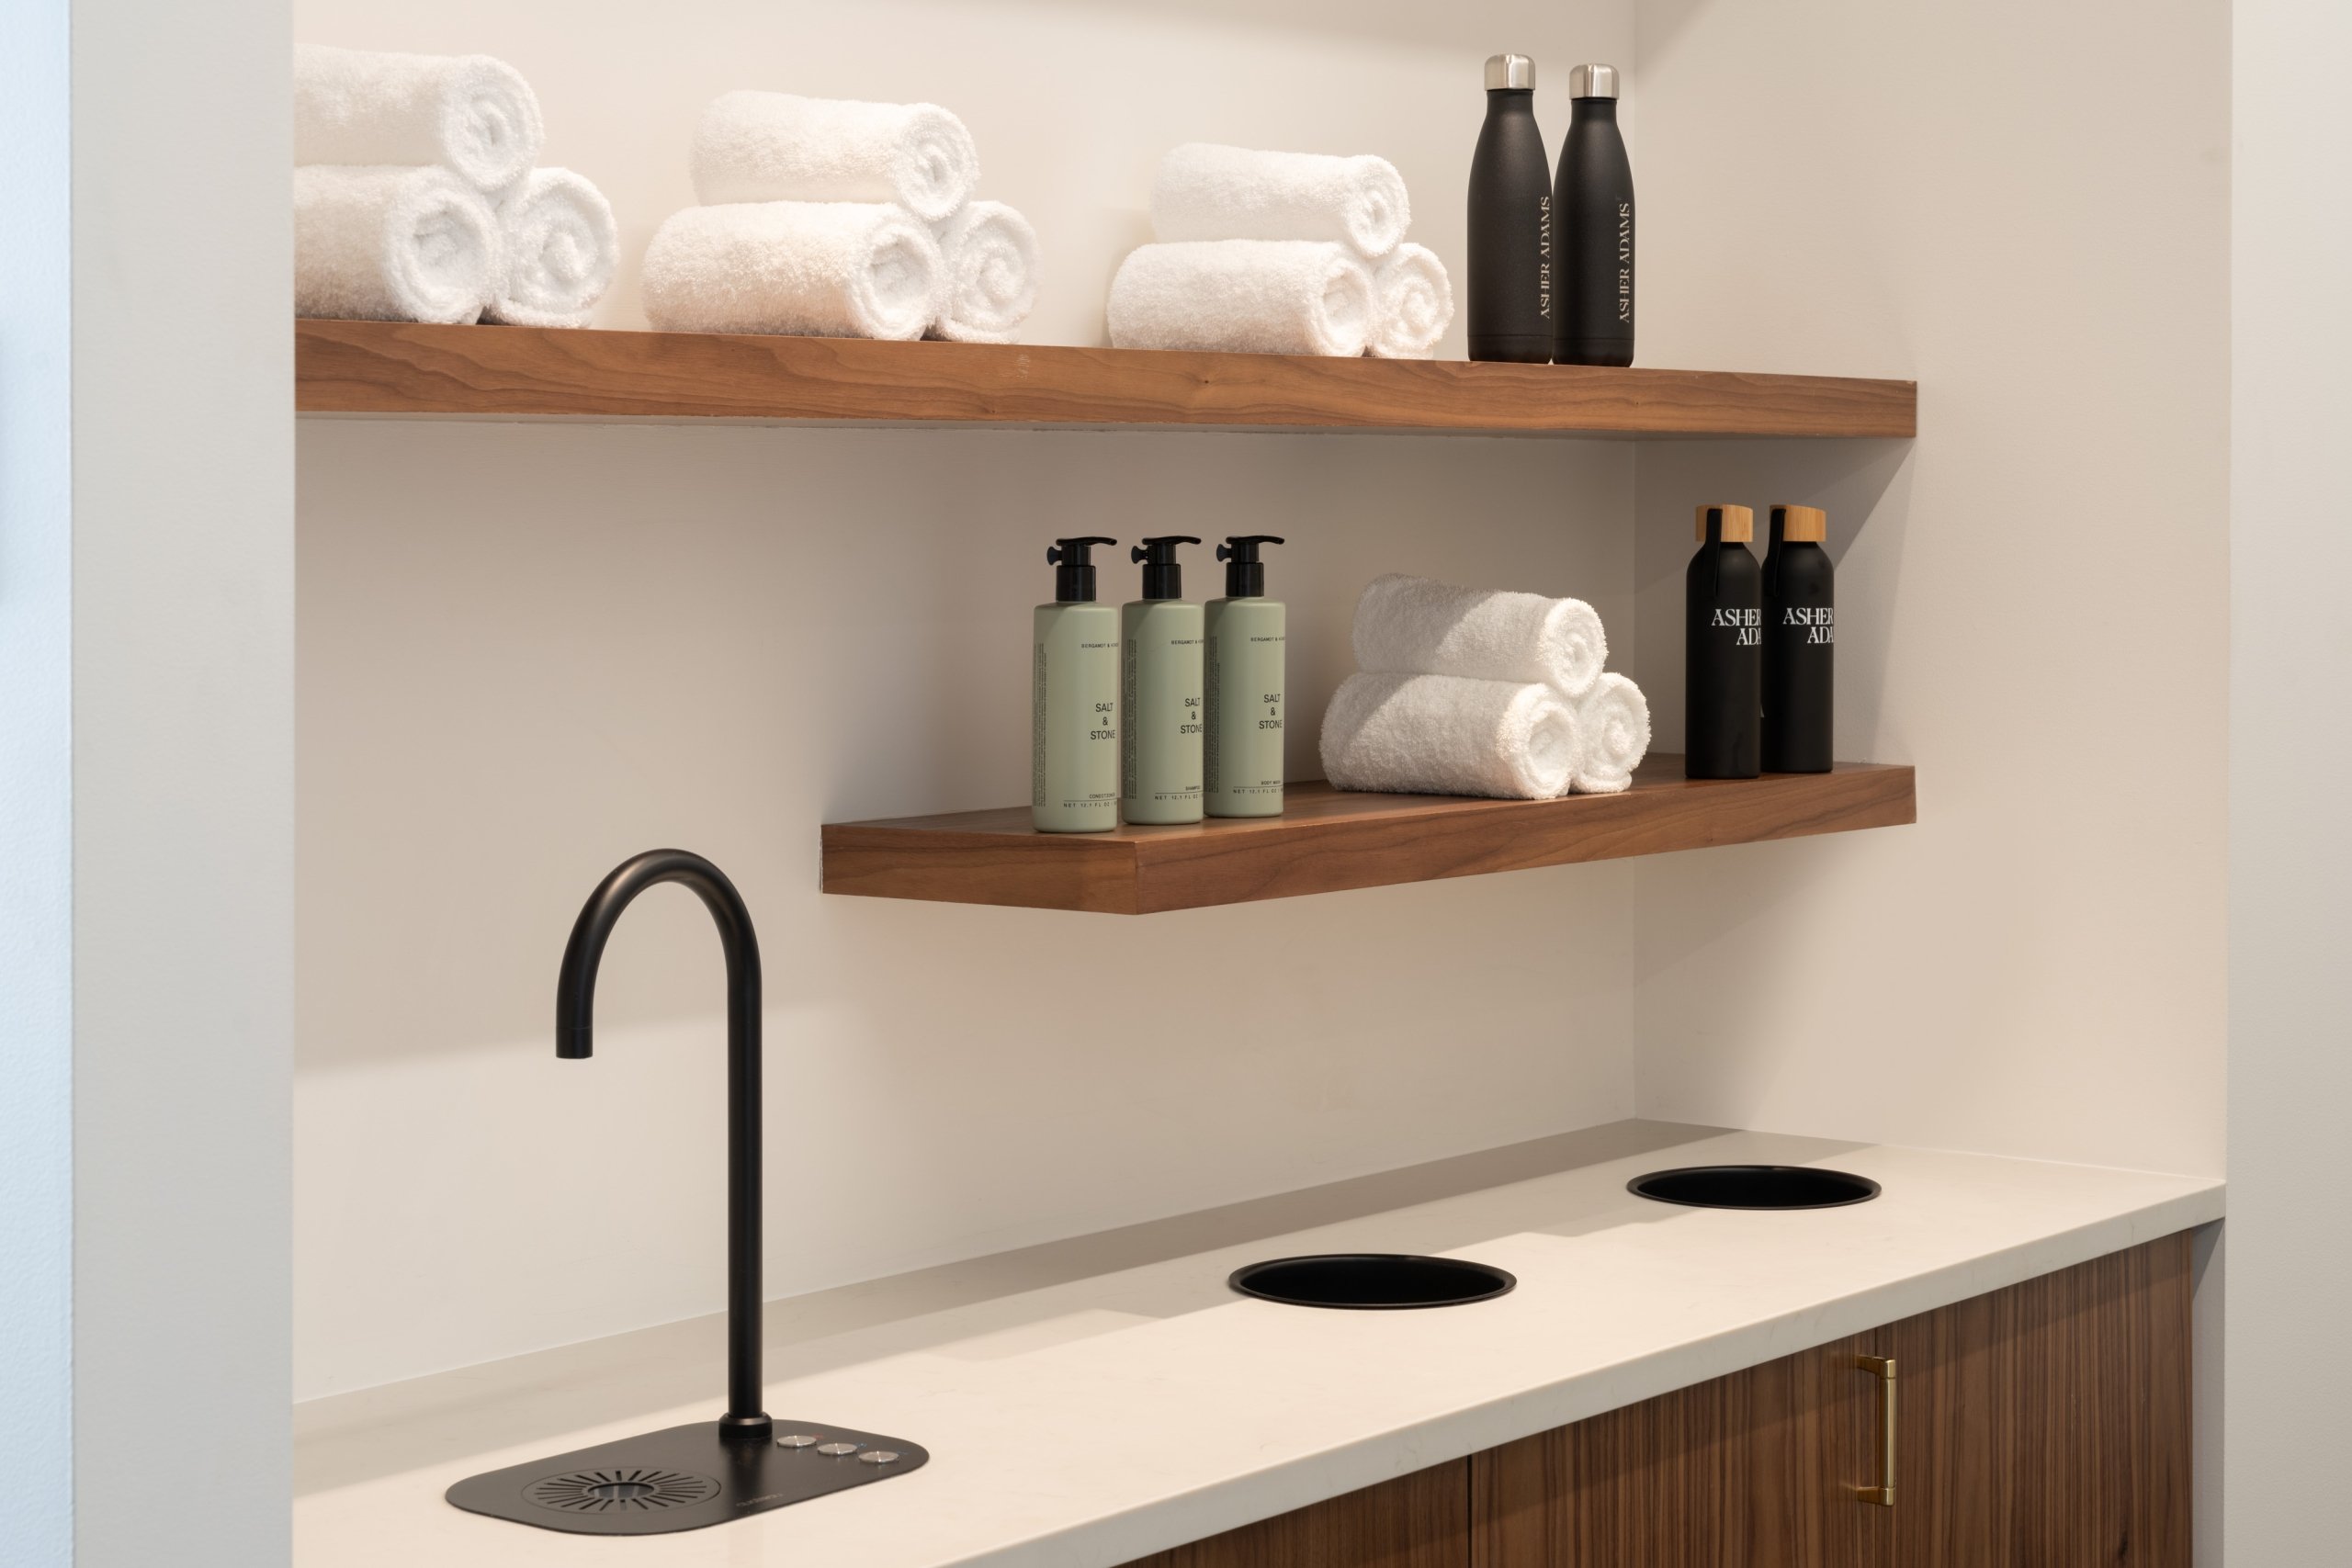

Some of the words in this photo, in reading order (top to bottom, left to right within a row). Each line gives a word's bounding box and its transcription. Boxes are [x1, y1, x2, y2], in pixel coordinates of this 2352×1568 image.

[1540, 196, 1550, 258] ADAMS
[1619, 202, 1630, 264] ADAMS
[1540, 262, 1550, 319] ASHER
[1619, 268, 1630, 323] ASHER
[1711, 608, 1762, 626] ASHER
[1782, 607, 1834, 626] ASHER
[1184, 697, 1201, 707] SALT
[1263, 694, 1281, 704] SALT
[1095, 703, 1114, 713] SALT
[1270, 706, 1276, 716] &
[1191, 711, 1196, 720] &
[1102, 716, 1108, 726] &
[1259, 719, 1283, 729] STONE
[1180, 724, 1203, 734] STONE
[1090, 729, 1115, 740] STONE
